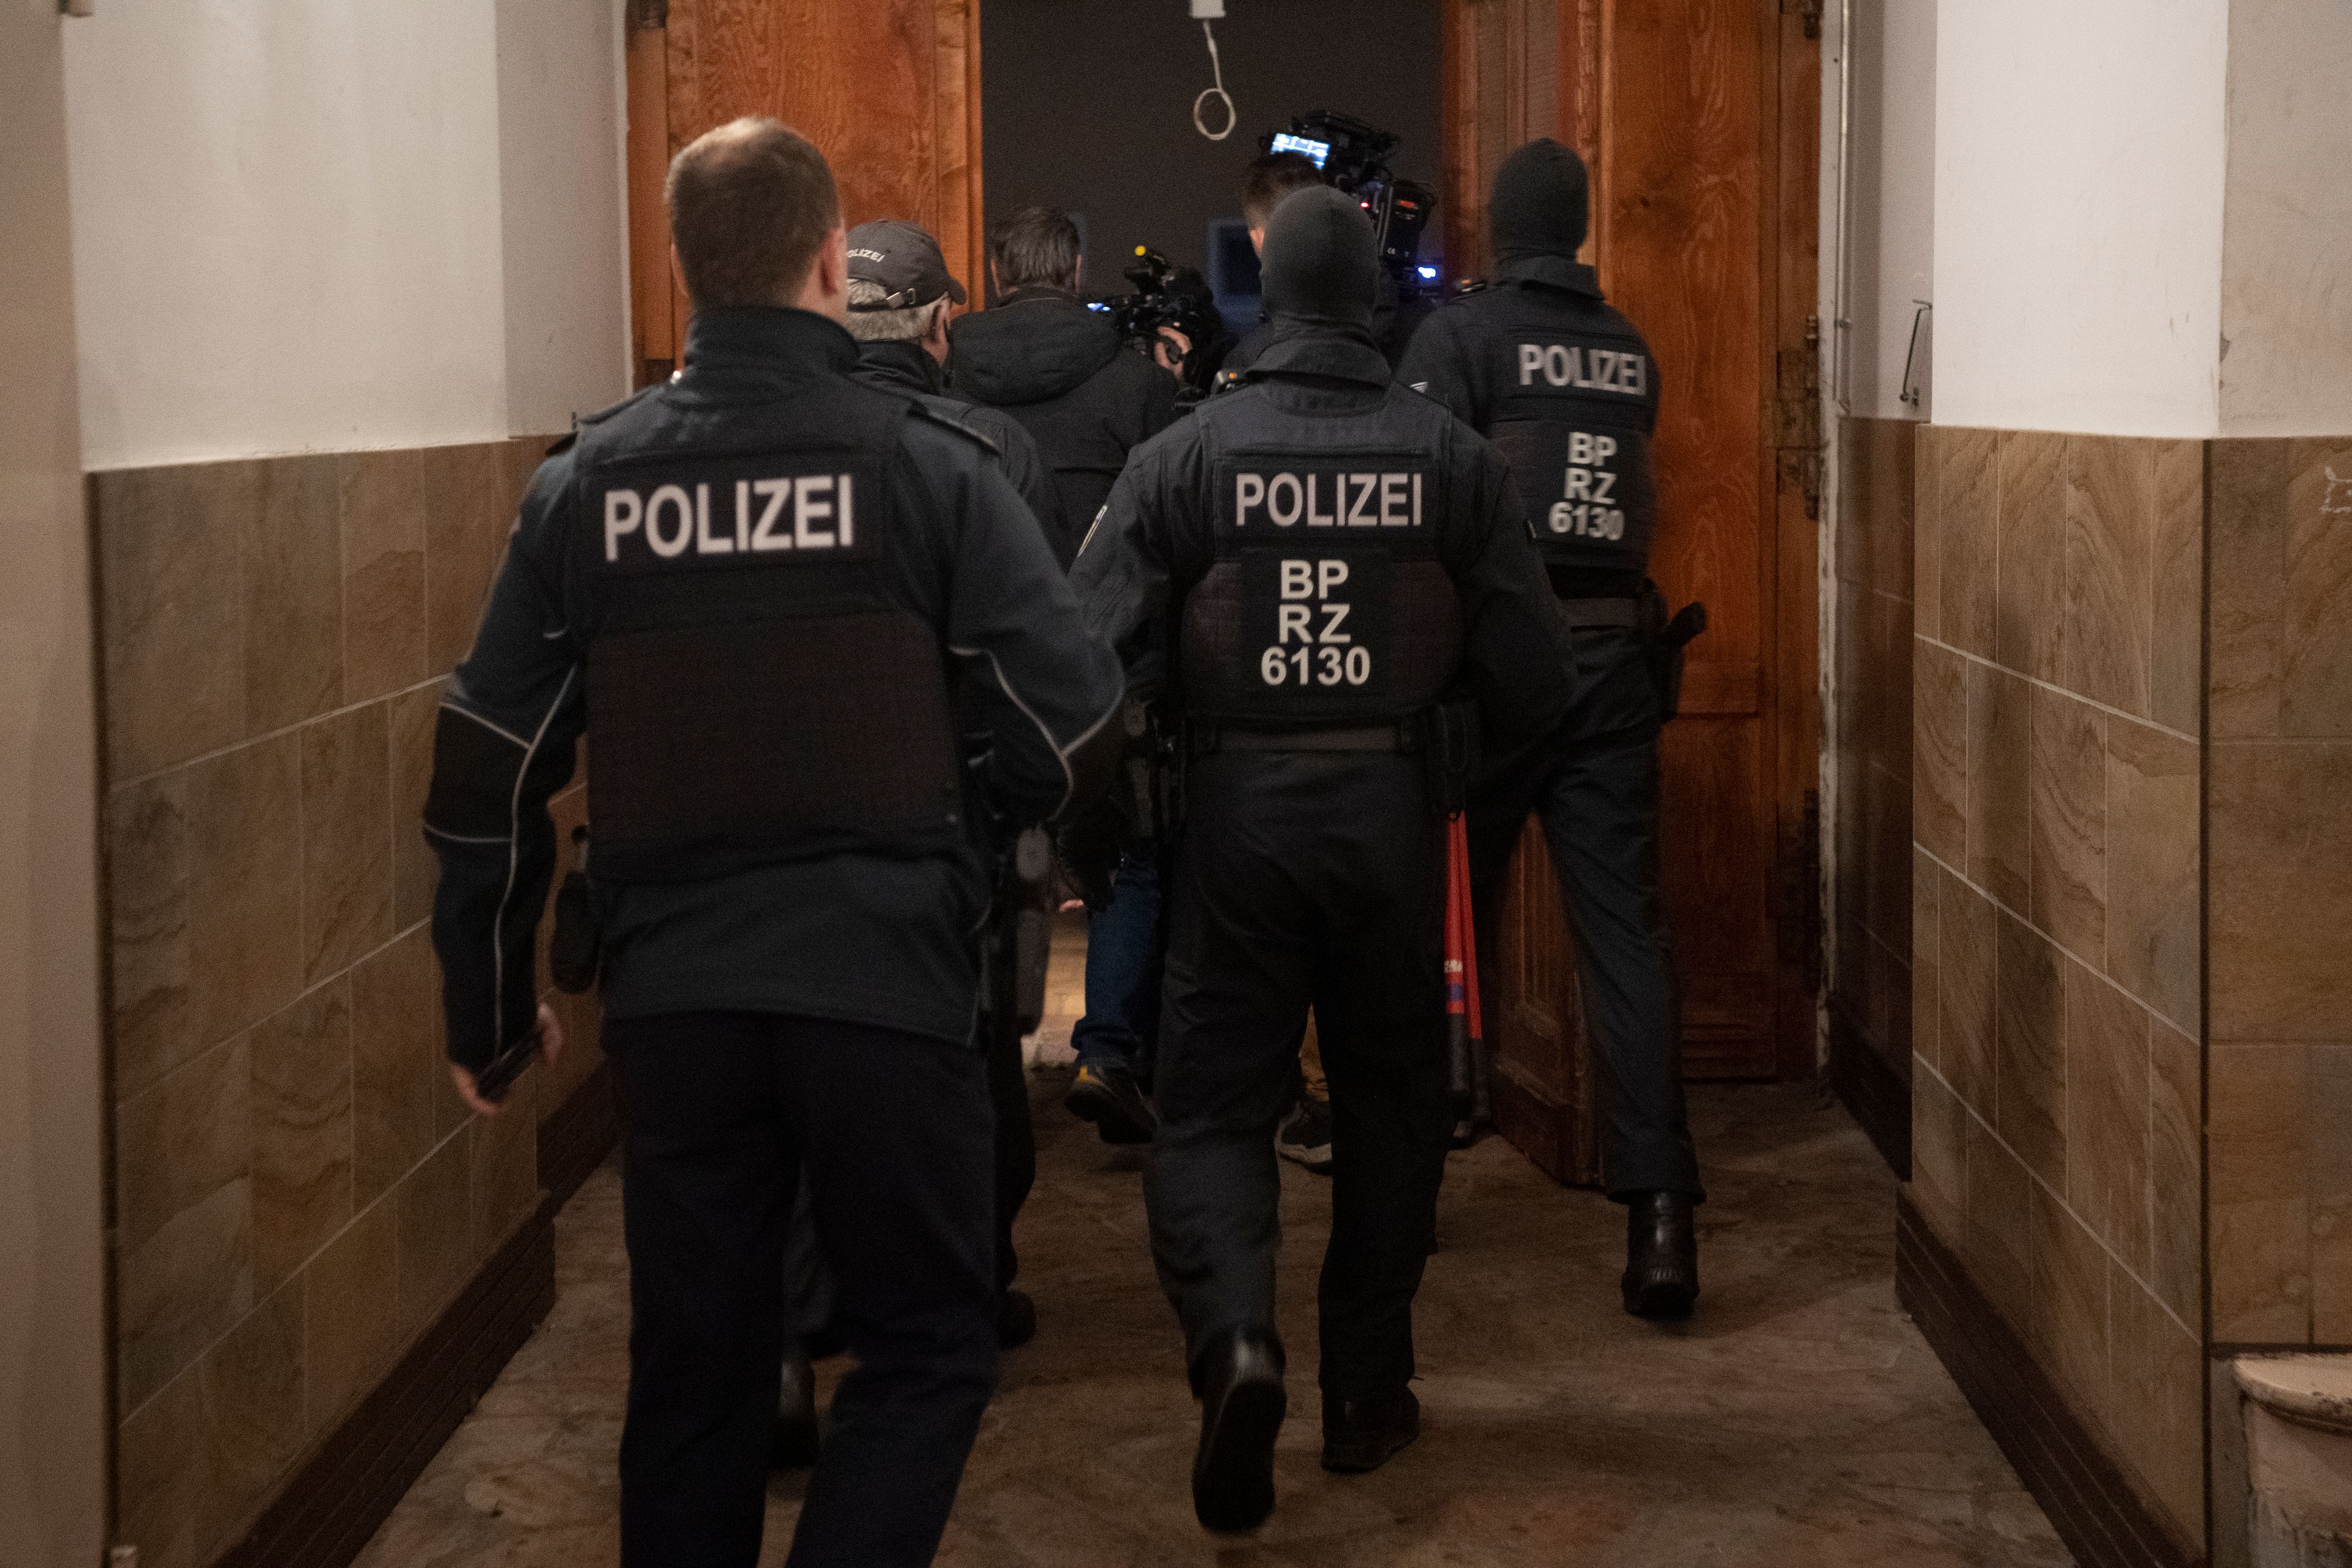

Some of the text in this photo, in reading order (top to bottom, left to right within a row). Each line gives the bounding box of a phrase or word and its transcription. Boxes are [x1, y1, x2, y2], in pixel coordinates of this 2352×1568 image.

[847, 248, 885, 262] OLIZEI
[1518, 343, 1646, 396] POLIZEI
[1568, 432, 1618, 466] BP
[1236, 472, 1422, 527] POLIZEI
[1564, 469, 1616, 504] RZ
[604, 473, 853, 563] POLIZEI
[1549, 502, 1625, 540] 6130
[1280, 559, 1349, 600] BP
[1278, 603, 1351, 644] RZ
[1261, 646, 1371, 686] 6130
